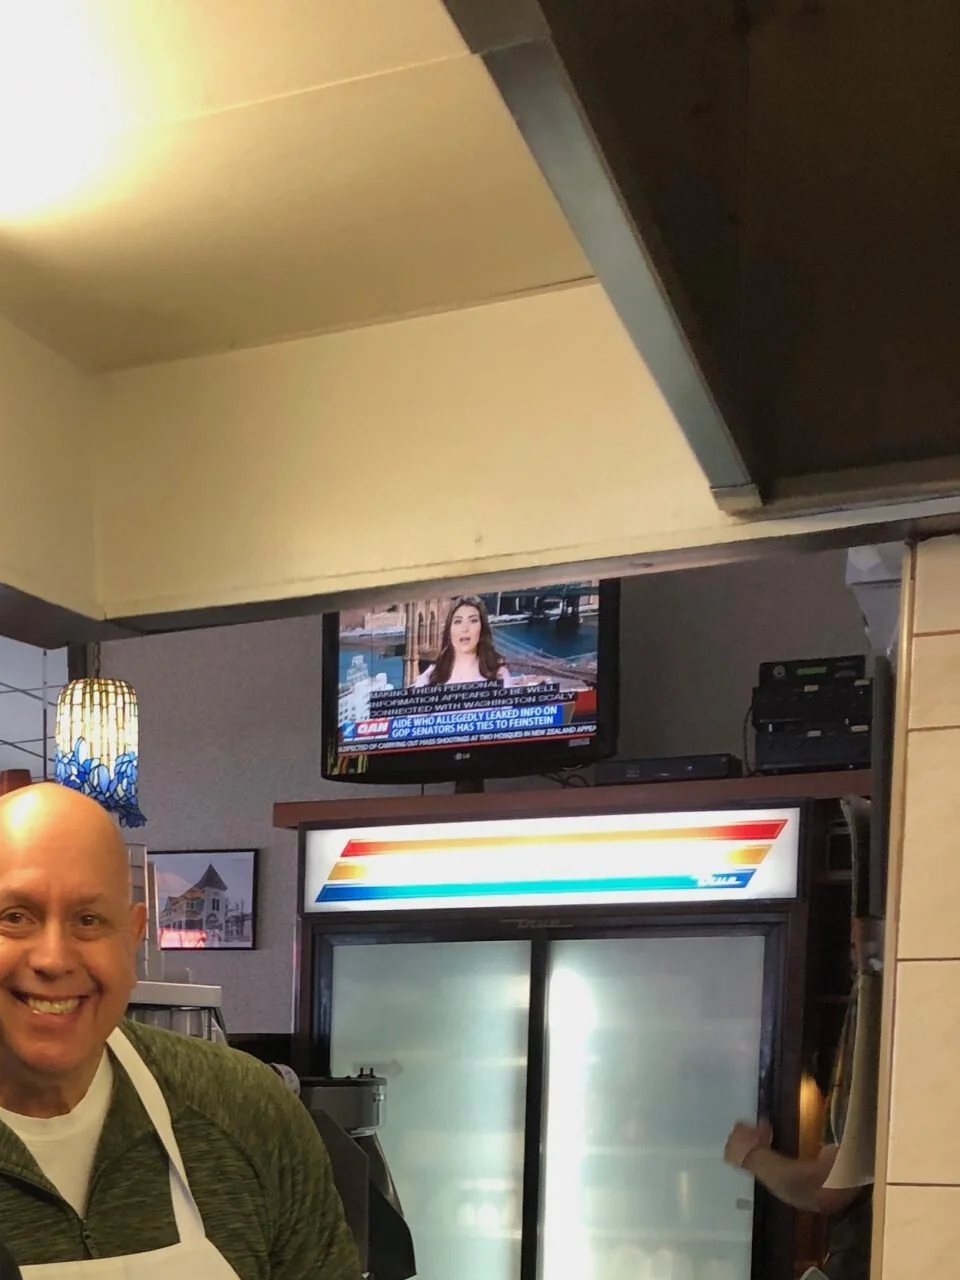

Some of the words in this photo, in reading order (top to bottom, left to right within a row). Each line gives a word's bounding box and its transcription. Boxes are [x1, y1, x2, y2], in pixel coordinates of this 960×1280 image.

[412, 685, 442, 695] THEIR
[493, 688, 507, 696] TO
[510, 687, 524, 695] BE
[527, 684, 557, 693] WELL
[370, 705, 432, 717] CONNECTED
[435, 702, 460, 711] WITH
[464, 696, 536, 708] WASHINGTON
[392, 718, 412, 729] AIDE
[413, 716, 435, 727] WHO
[436, 712, 484, 725] ALLEGEDLY
[486, 708, 519, 720] LEAKED
[520, 706, 542, 717] INFO
[543, 705, 558, 715] ON
[392, 727, 411, 738] GOP
[412, 723, 455, 736] SENATORS
[456, 721, 474, 732] HAS
[476, 719, 494, 730] TIES
[495, 718, 508, 729] TO
[509, 714, 554, 727] FEINSTEIN
[546, 726, 576, 735] ZEALAND
